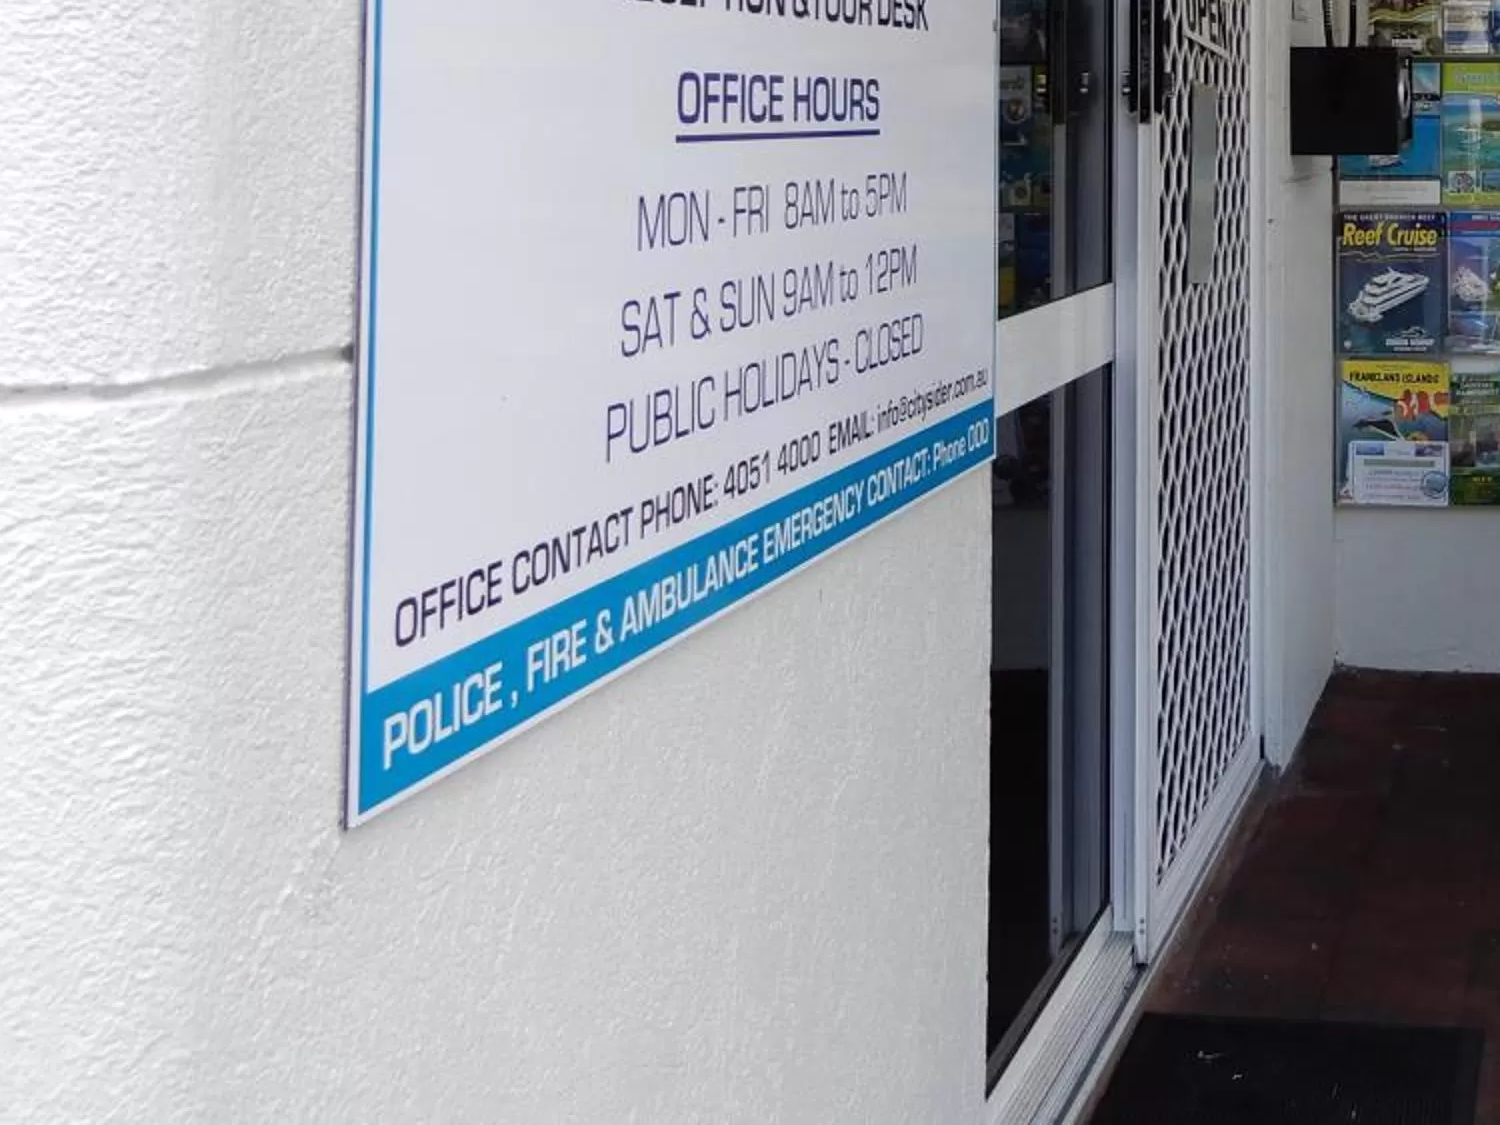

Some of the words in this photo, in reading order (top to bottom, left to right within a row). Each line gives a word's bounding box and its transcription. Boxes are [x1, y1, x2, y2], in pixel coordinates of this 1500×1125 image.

[677, 72, 784, 123] OFFICE
[793, 79, 880, 122] HOURS
[637, 191, 709, 251] MON
[733, 186, 768, 238] FRI
[784, 178, 834, 230] 8AM
[842, 181, 859, 221] to
[865, 172, 907, 217] 5PM
[1342, 222, 1384, 246] Reef
[1387, 222, 1438, 246] Cruise
[621, 291, 680, 358] SAT
[692, 288, 711, 339] &
[720, 275, 776, 334] SUN
[783, 263, 833, 317] 9AM
[839, 263, 857, 304] to
[865, 244, 917, 295] 12PM
[607, 377, 715, 463] PUBLIC
[725, 338, 840, 421] HOLIDAYS
[855, 313, 924, 375] CLOSED
[396, 561, 502, 648] OFFICE
[512, 507, 632, 597] CONTACT
[641, 473, 718, 540] PHONE:
[724, 456, 770, 501] 4051
[777, 431, 820, 475] 4000
[829, 411, 875, 456] EMAIL:
[877, 369, 988, 434] info@citysider.com.au
[382, 662, 502, 771] POLICE
[527, 621, 587, 694] FIRE
[595, 610, 613, 654] &
[620, 533, 759, 642] AMBULANCE
[763, 484, 864, 563] EMERGENCY
[868, 452, 931, 505] CONTACT:
[933, 434, 966, 473] Phone
[968, 418, 989, 452] 000
